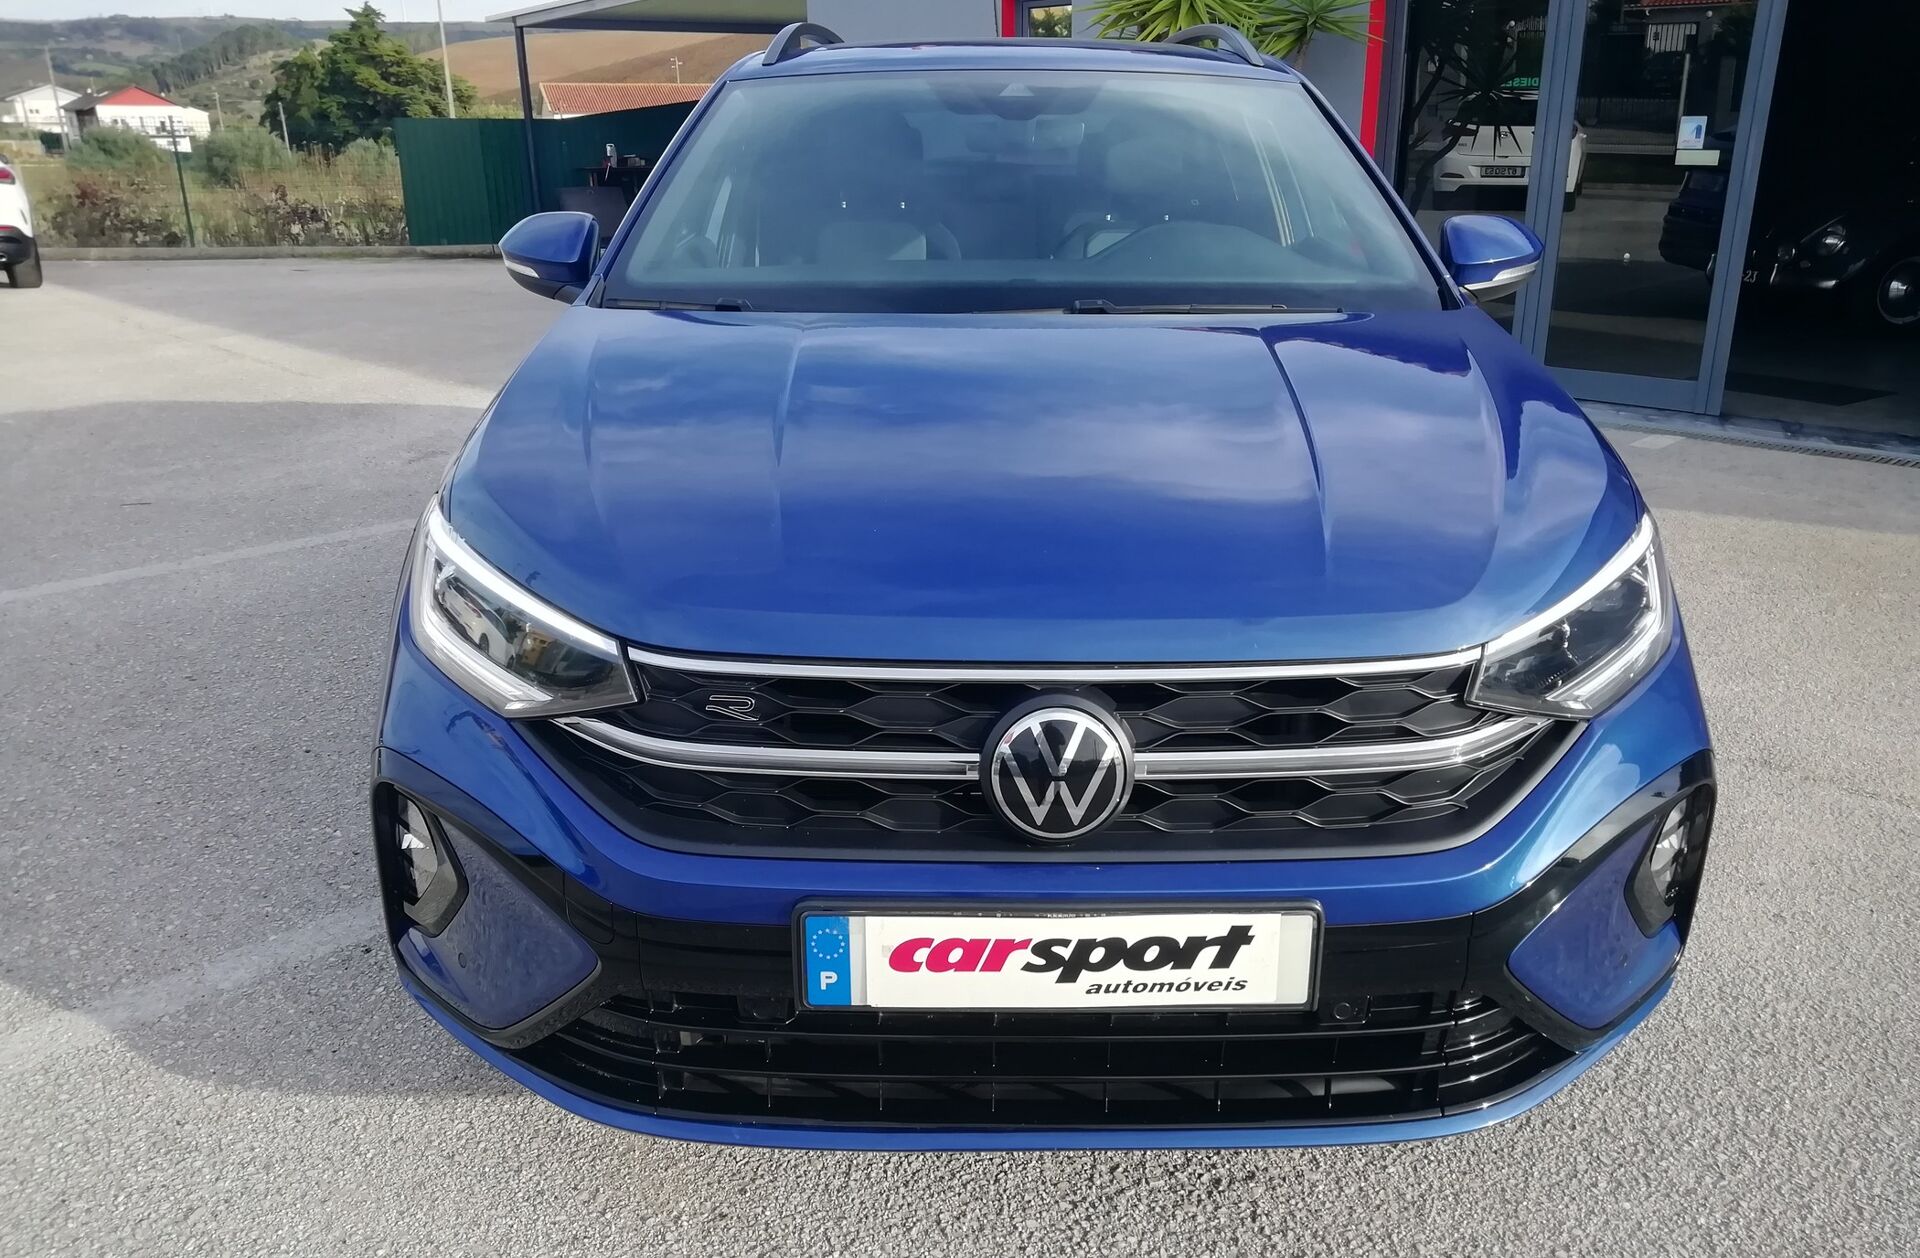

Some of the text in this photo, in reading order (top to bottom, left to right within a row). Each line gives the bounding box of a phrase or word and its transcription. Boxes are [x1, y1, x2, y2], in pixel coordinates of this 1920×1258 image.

[889, 925, 1255, 983] carsport
[820, 971, 838, 990] P
[1085, 977, 1248, 995] automóveis
